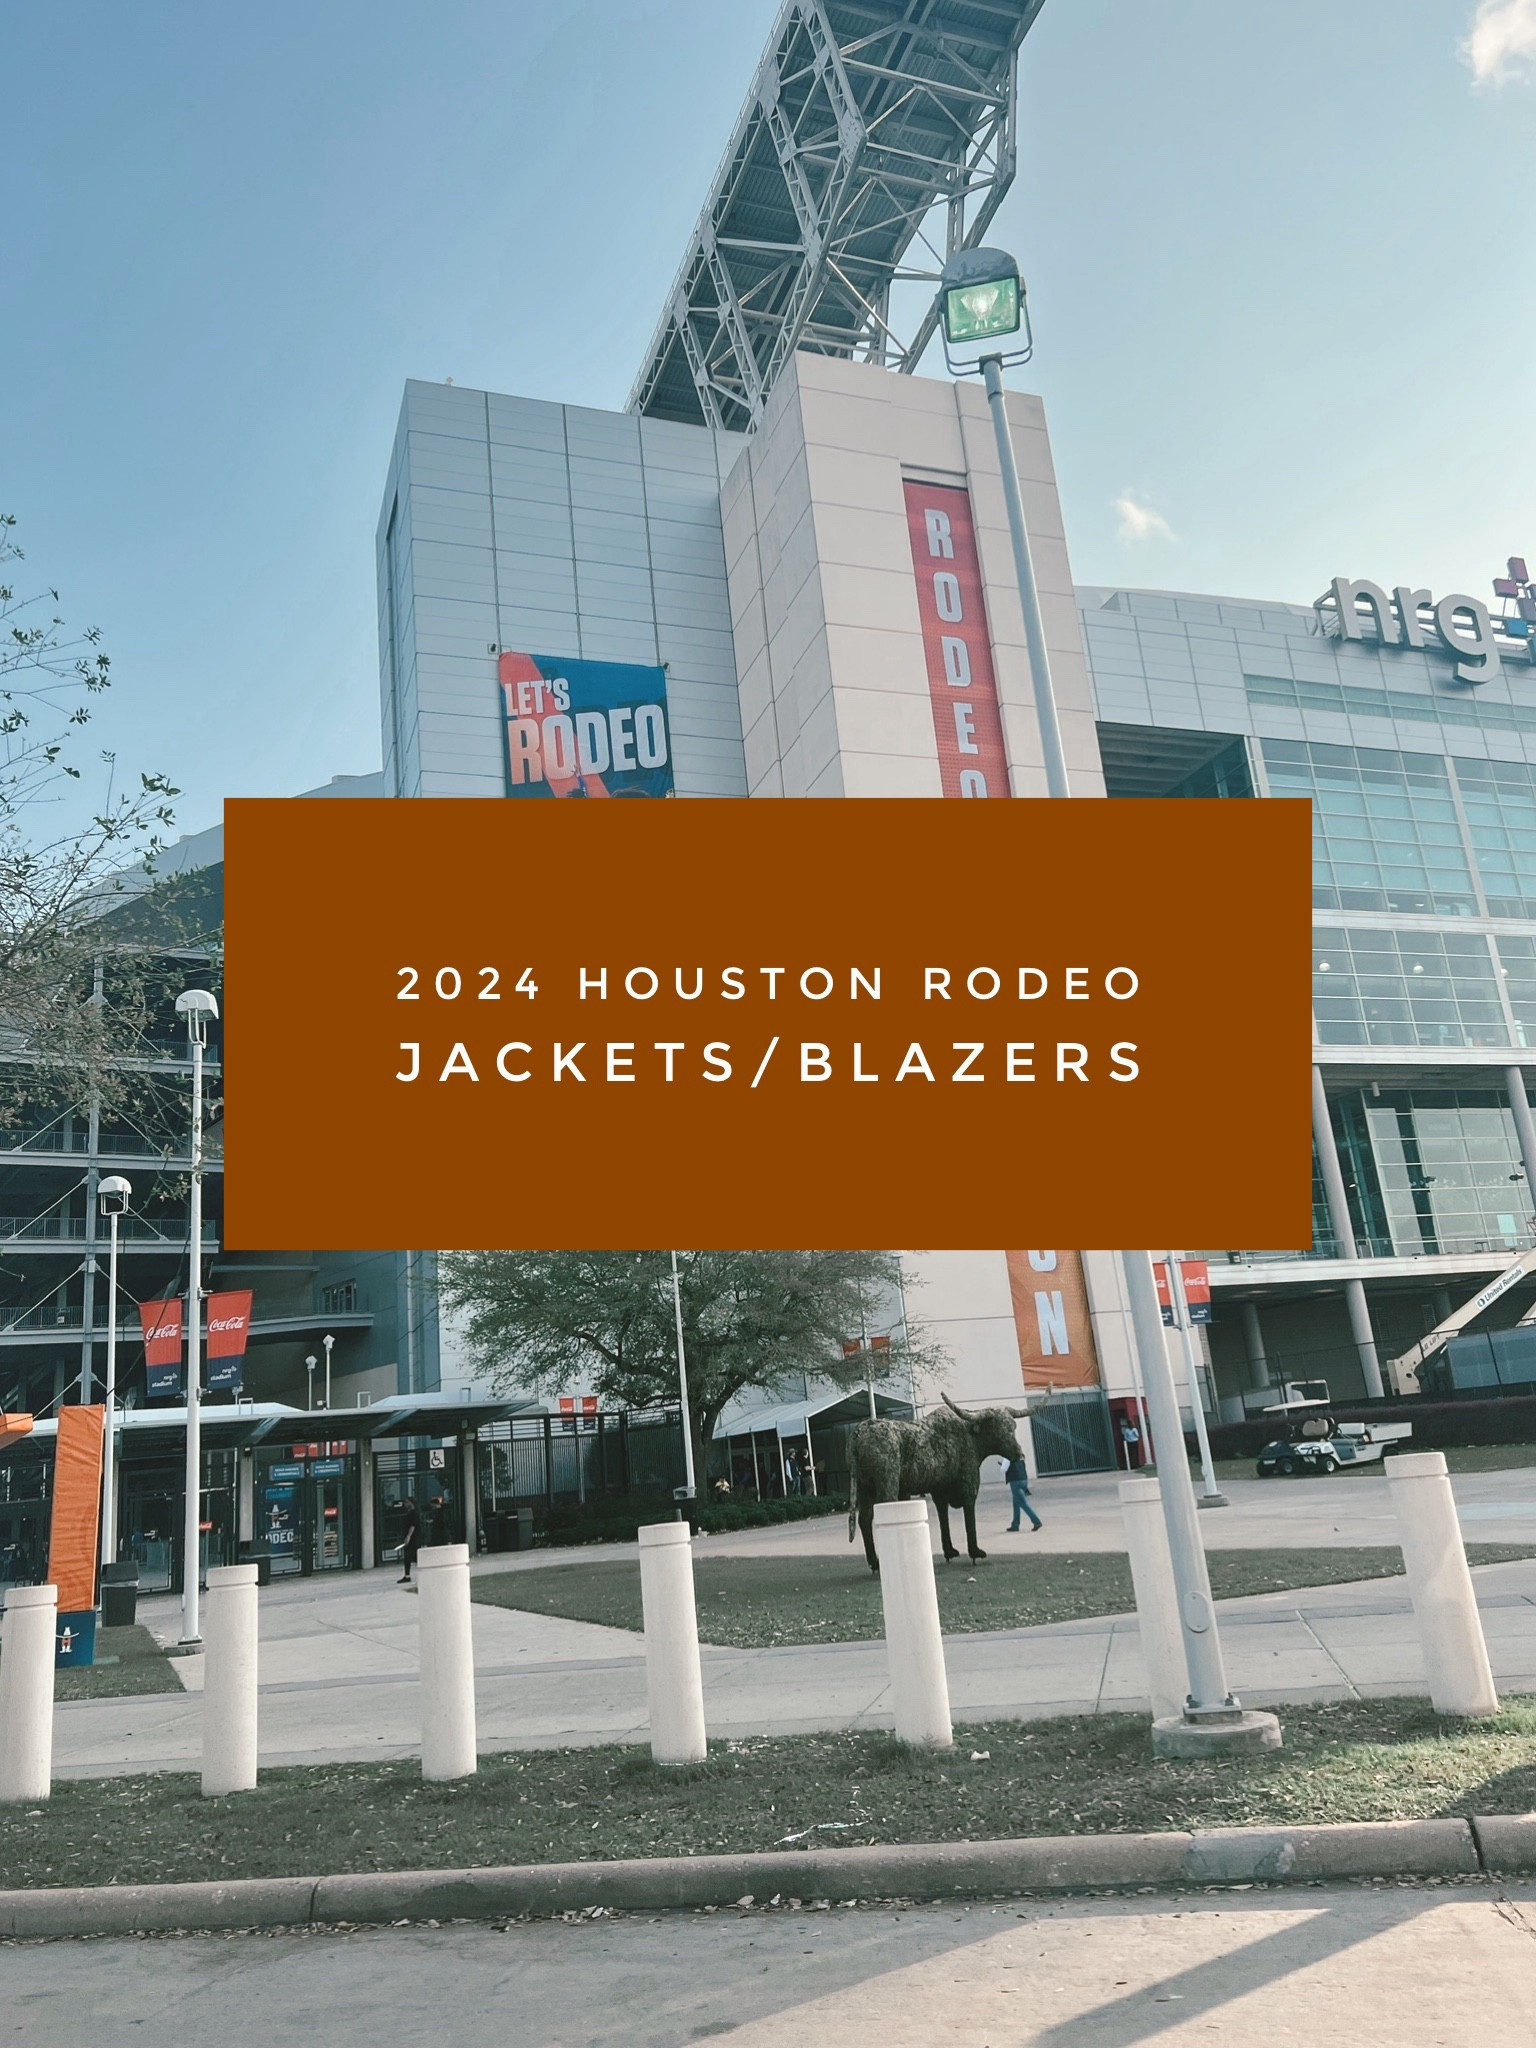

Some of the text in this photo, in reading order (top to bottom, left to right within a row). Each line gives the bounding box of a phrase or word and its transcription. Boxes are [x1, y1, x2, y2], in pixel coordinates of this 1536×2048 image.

[1331, 576, 1501, 685] nrg
[505, 677, 571, 718] LET'S
[507, 704, 669, 786] RODEO
[1484, 1268, 1522, 1302] United Rentals
